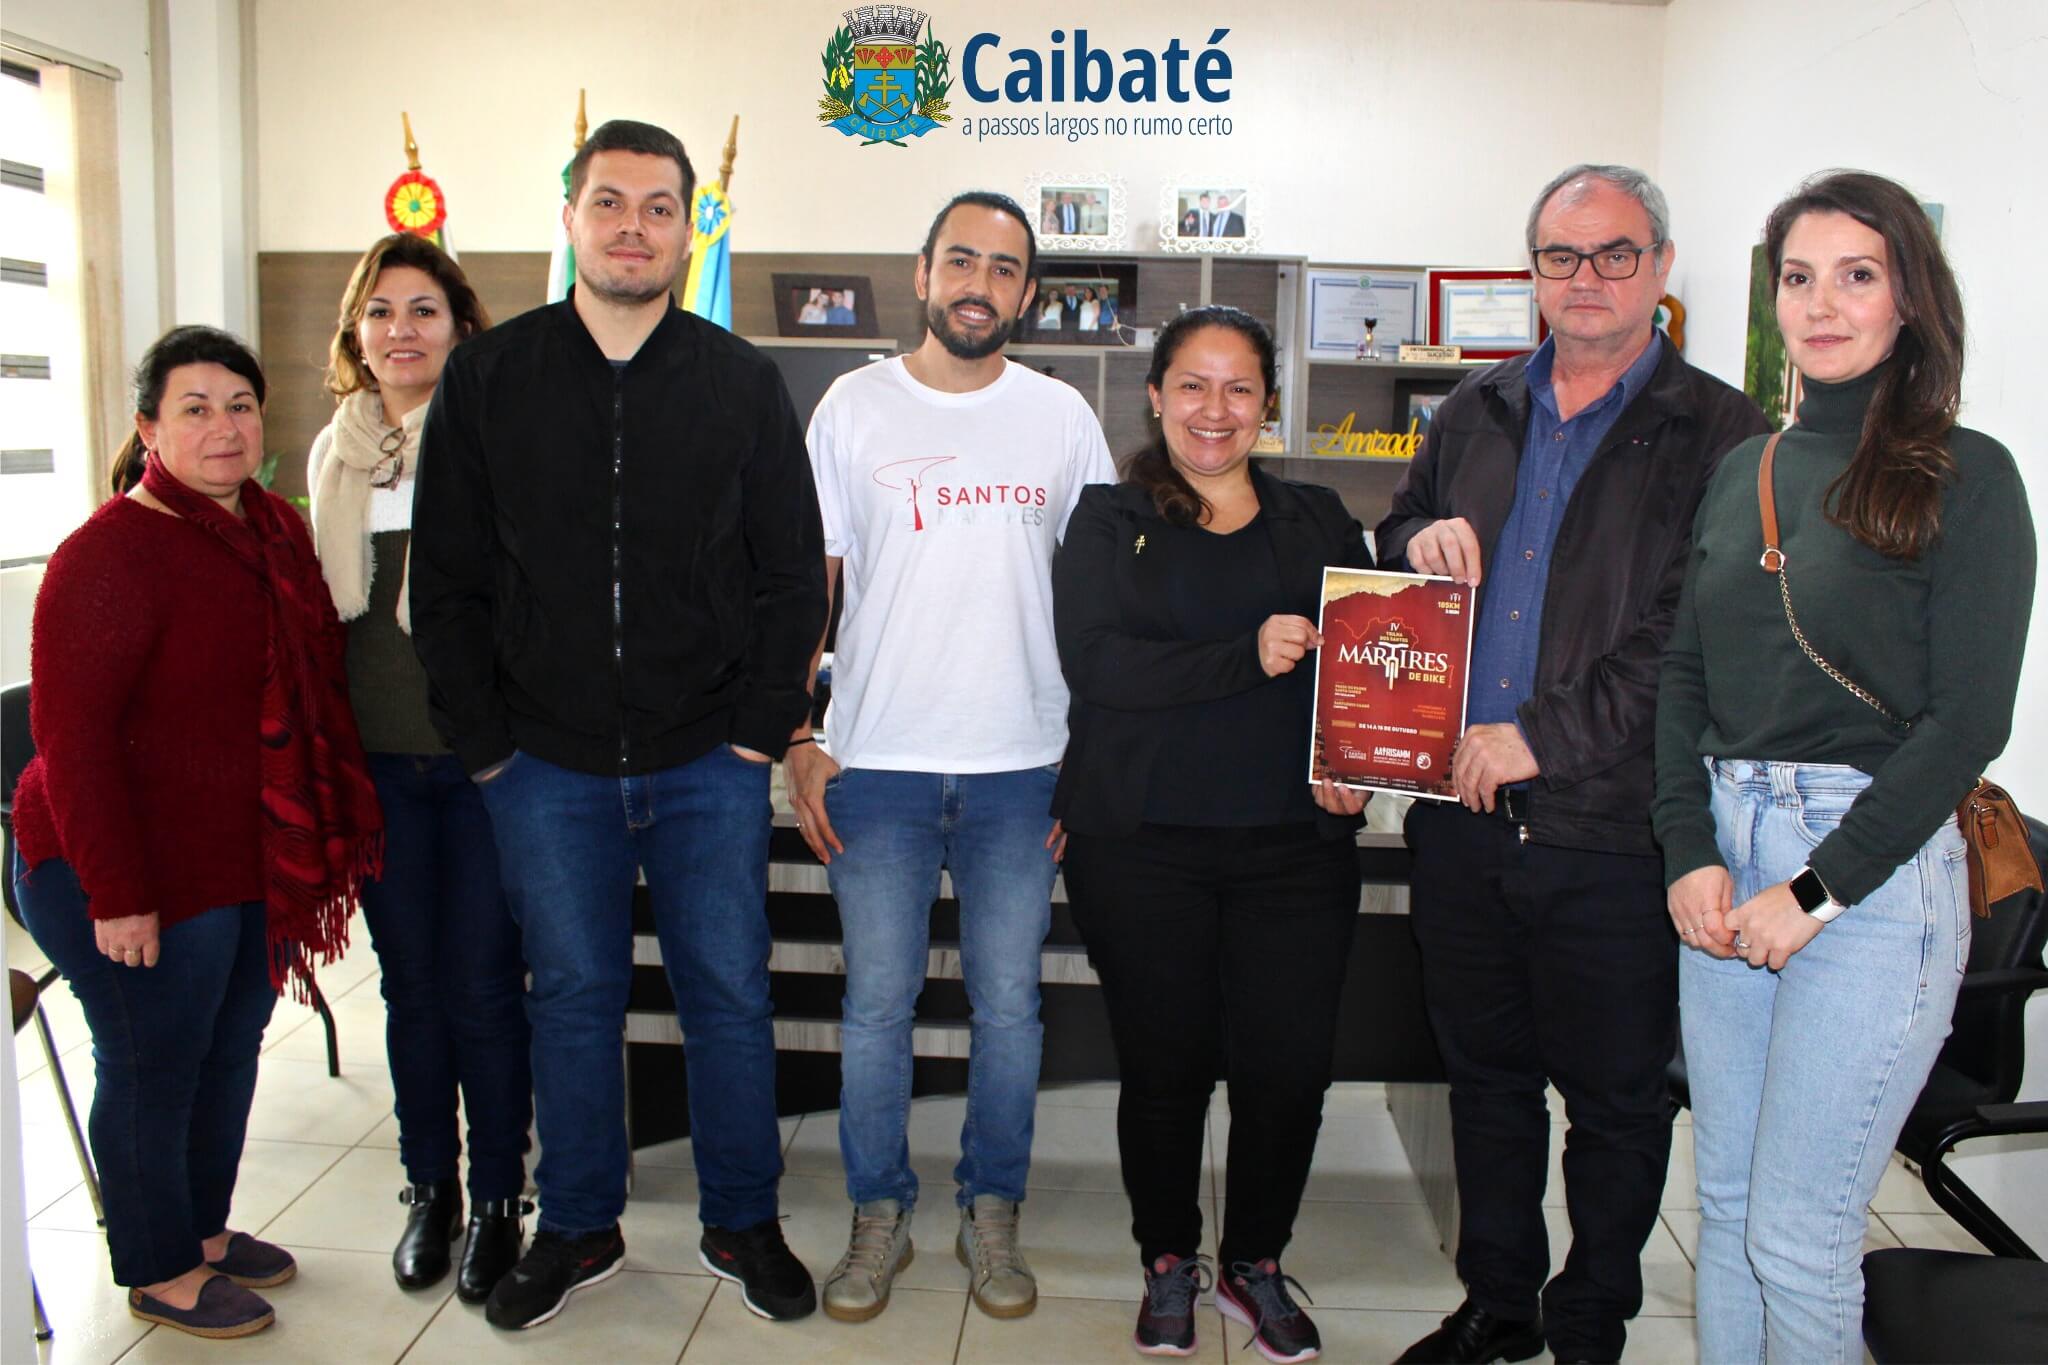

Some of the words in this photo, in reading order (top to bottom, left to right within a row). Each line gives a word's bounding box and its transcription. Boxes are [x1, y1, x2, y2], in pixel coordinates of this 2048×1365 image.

[1311, 411, 1424, 457] Amizade
[937, 485, 1046, 506] SANTOS
[1390, 622, 1400, 631] IV
[1337, 641, 1448, 678] MÁRTIRES
[1408, 672, 1422, 681] DE
[1423, 674, 1446, 684] BIKE
